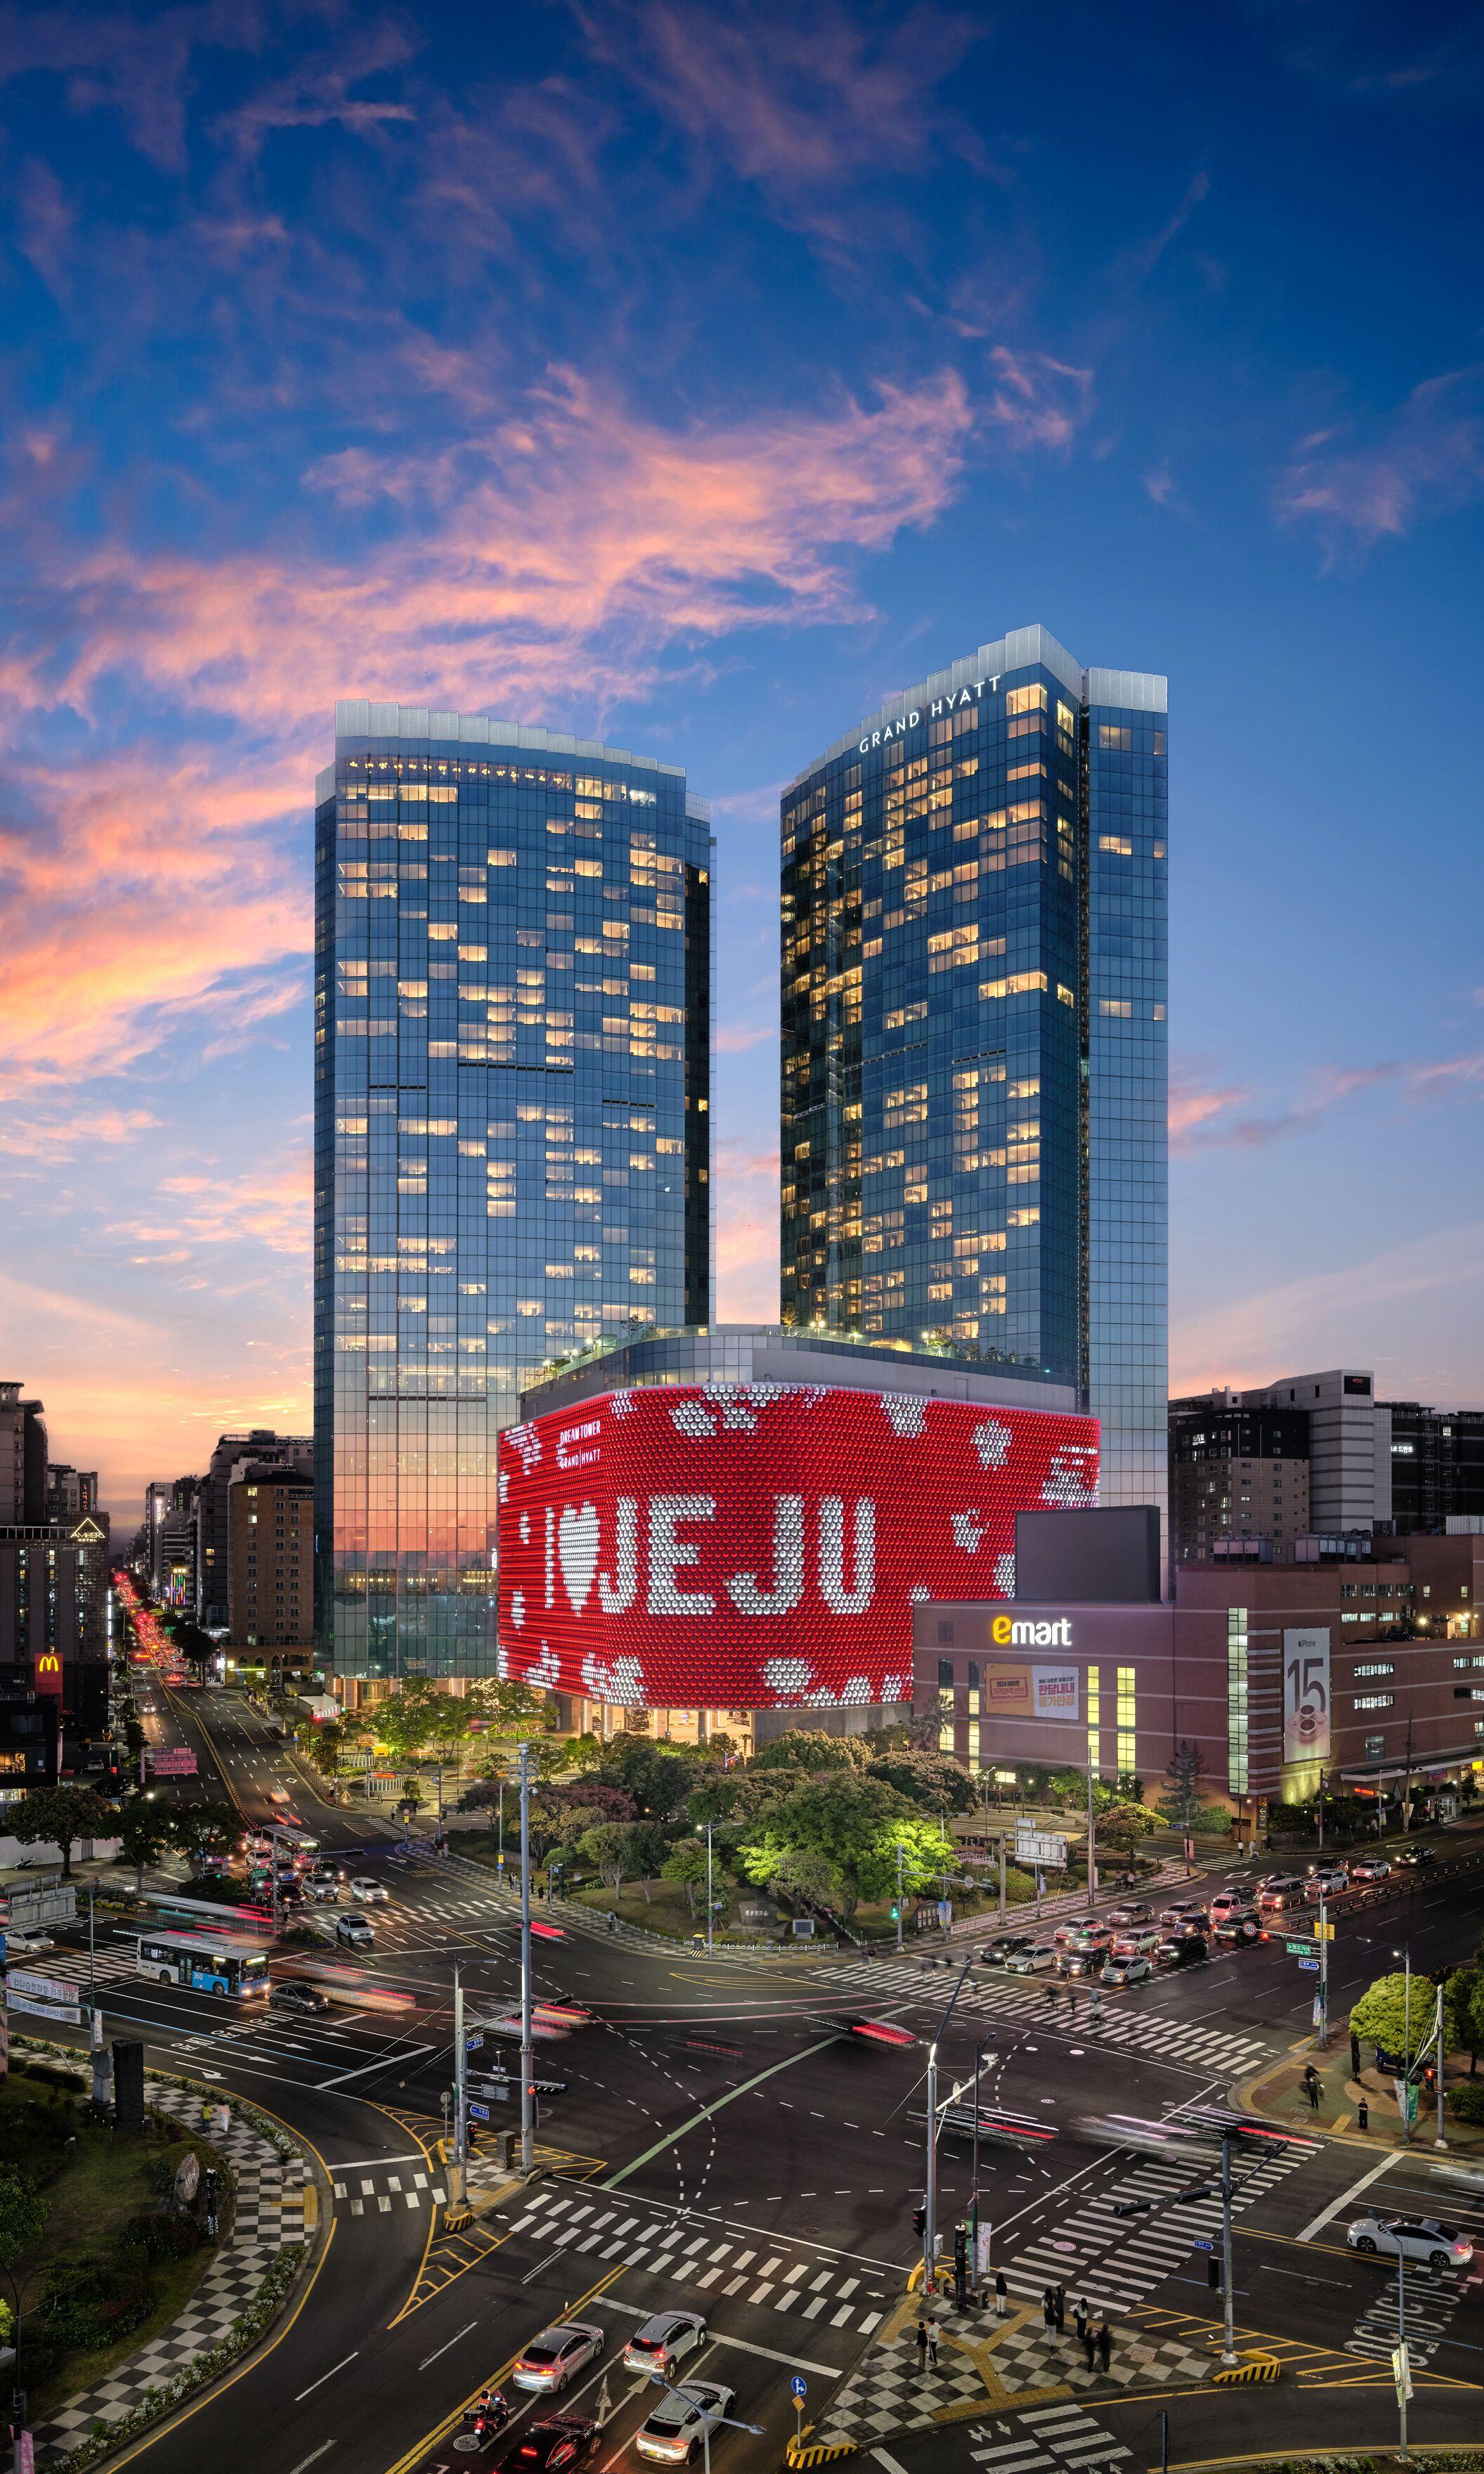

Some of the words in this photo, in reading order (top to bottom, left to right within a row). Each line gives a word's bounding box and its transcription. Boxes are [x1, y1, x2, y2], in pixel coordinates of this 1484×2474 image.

[859, 711, 919, 753] GRAND
[932, 675, 1001, 717] HYATT
[560, 1427, 580, 1445] DREAM
[580, 1420, 601, 1438] TOWER
[559, 1454, 579, 1469] GRAND
[582, 1449, 601, 1464] HYATT
[597, 1493, 876, 1615] JEJU
[993, 1617, 1072, 1646] emart
[1039, 1682, 1074, 1695] 한달내내
[1287, 1657, 1326, 1714] 15
[1039, 1695, 1074, 1708] 물가안정
[193, 1972, 203, 1981] 360
